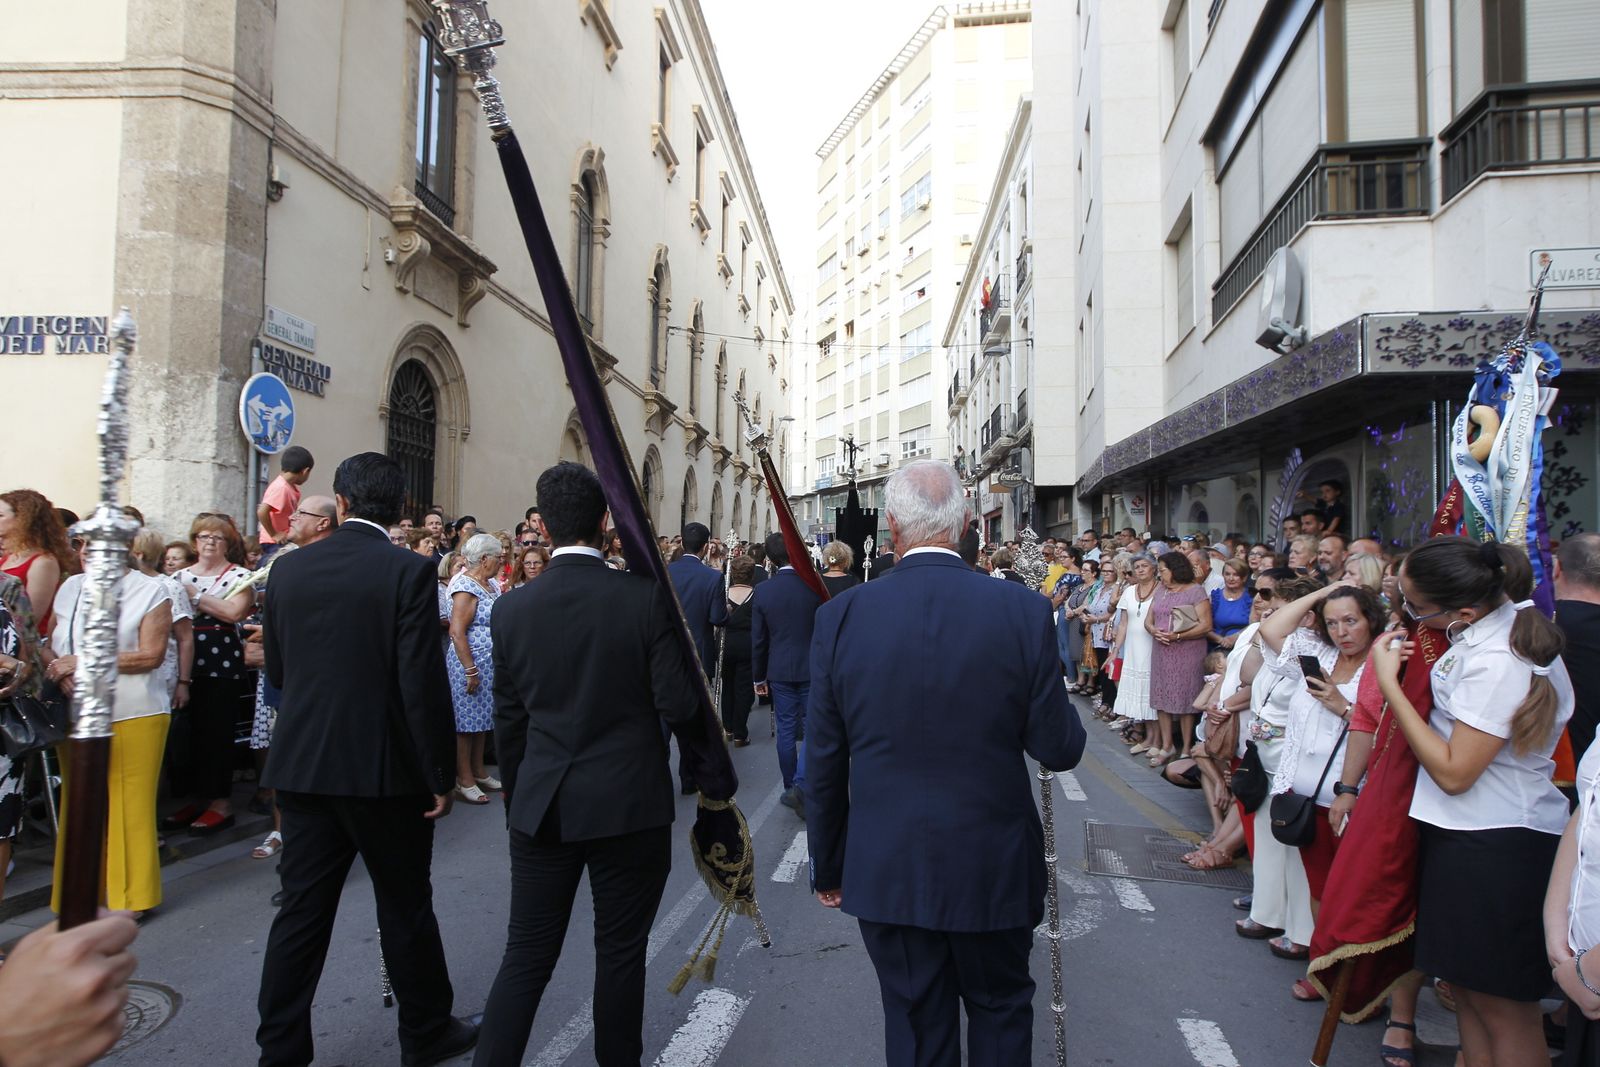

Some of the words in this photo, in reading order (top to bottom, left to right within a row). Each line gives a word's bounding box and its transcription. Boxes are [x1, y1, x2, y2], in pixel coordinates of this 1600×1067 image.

[0, 316, 106, 335] VIRGEN
[287, 317, 304, 329] CALLE
[56, 335, 109, 354] MAR
[268, 321, 293, 341] GENERAL
[294, 331, 314, 349] TAMAYO
[262, 343, 329, 380] GENERAL
[1513, 393, 1534, 462] ENCUENTRO
[1456, 453, 1465, 466] de
[1465, 472, 1493, 516] Bandas
[1505, 467, 1519, 482] DE
